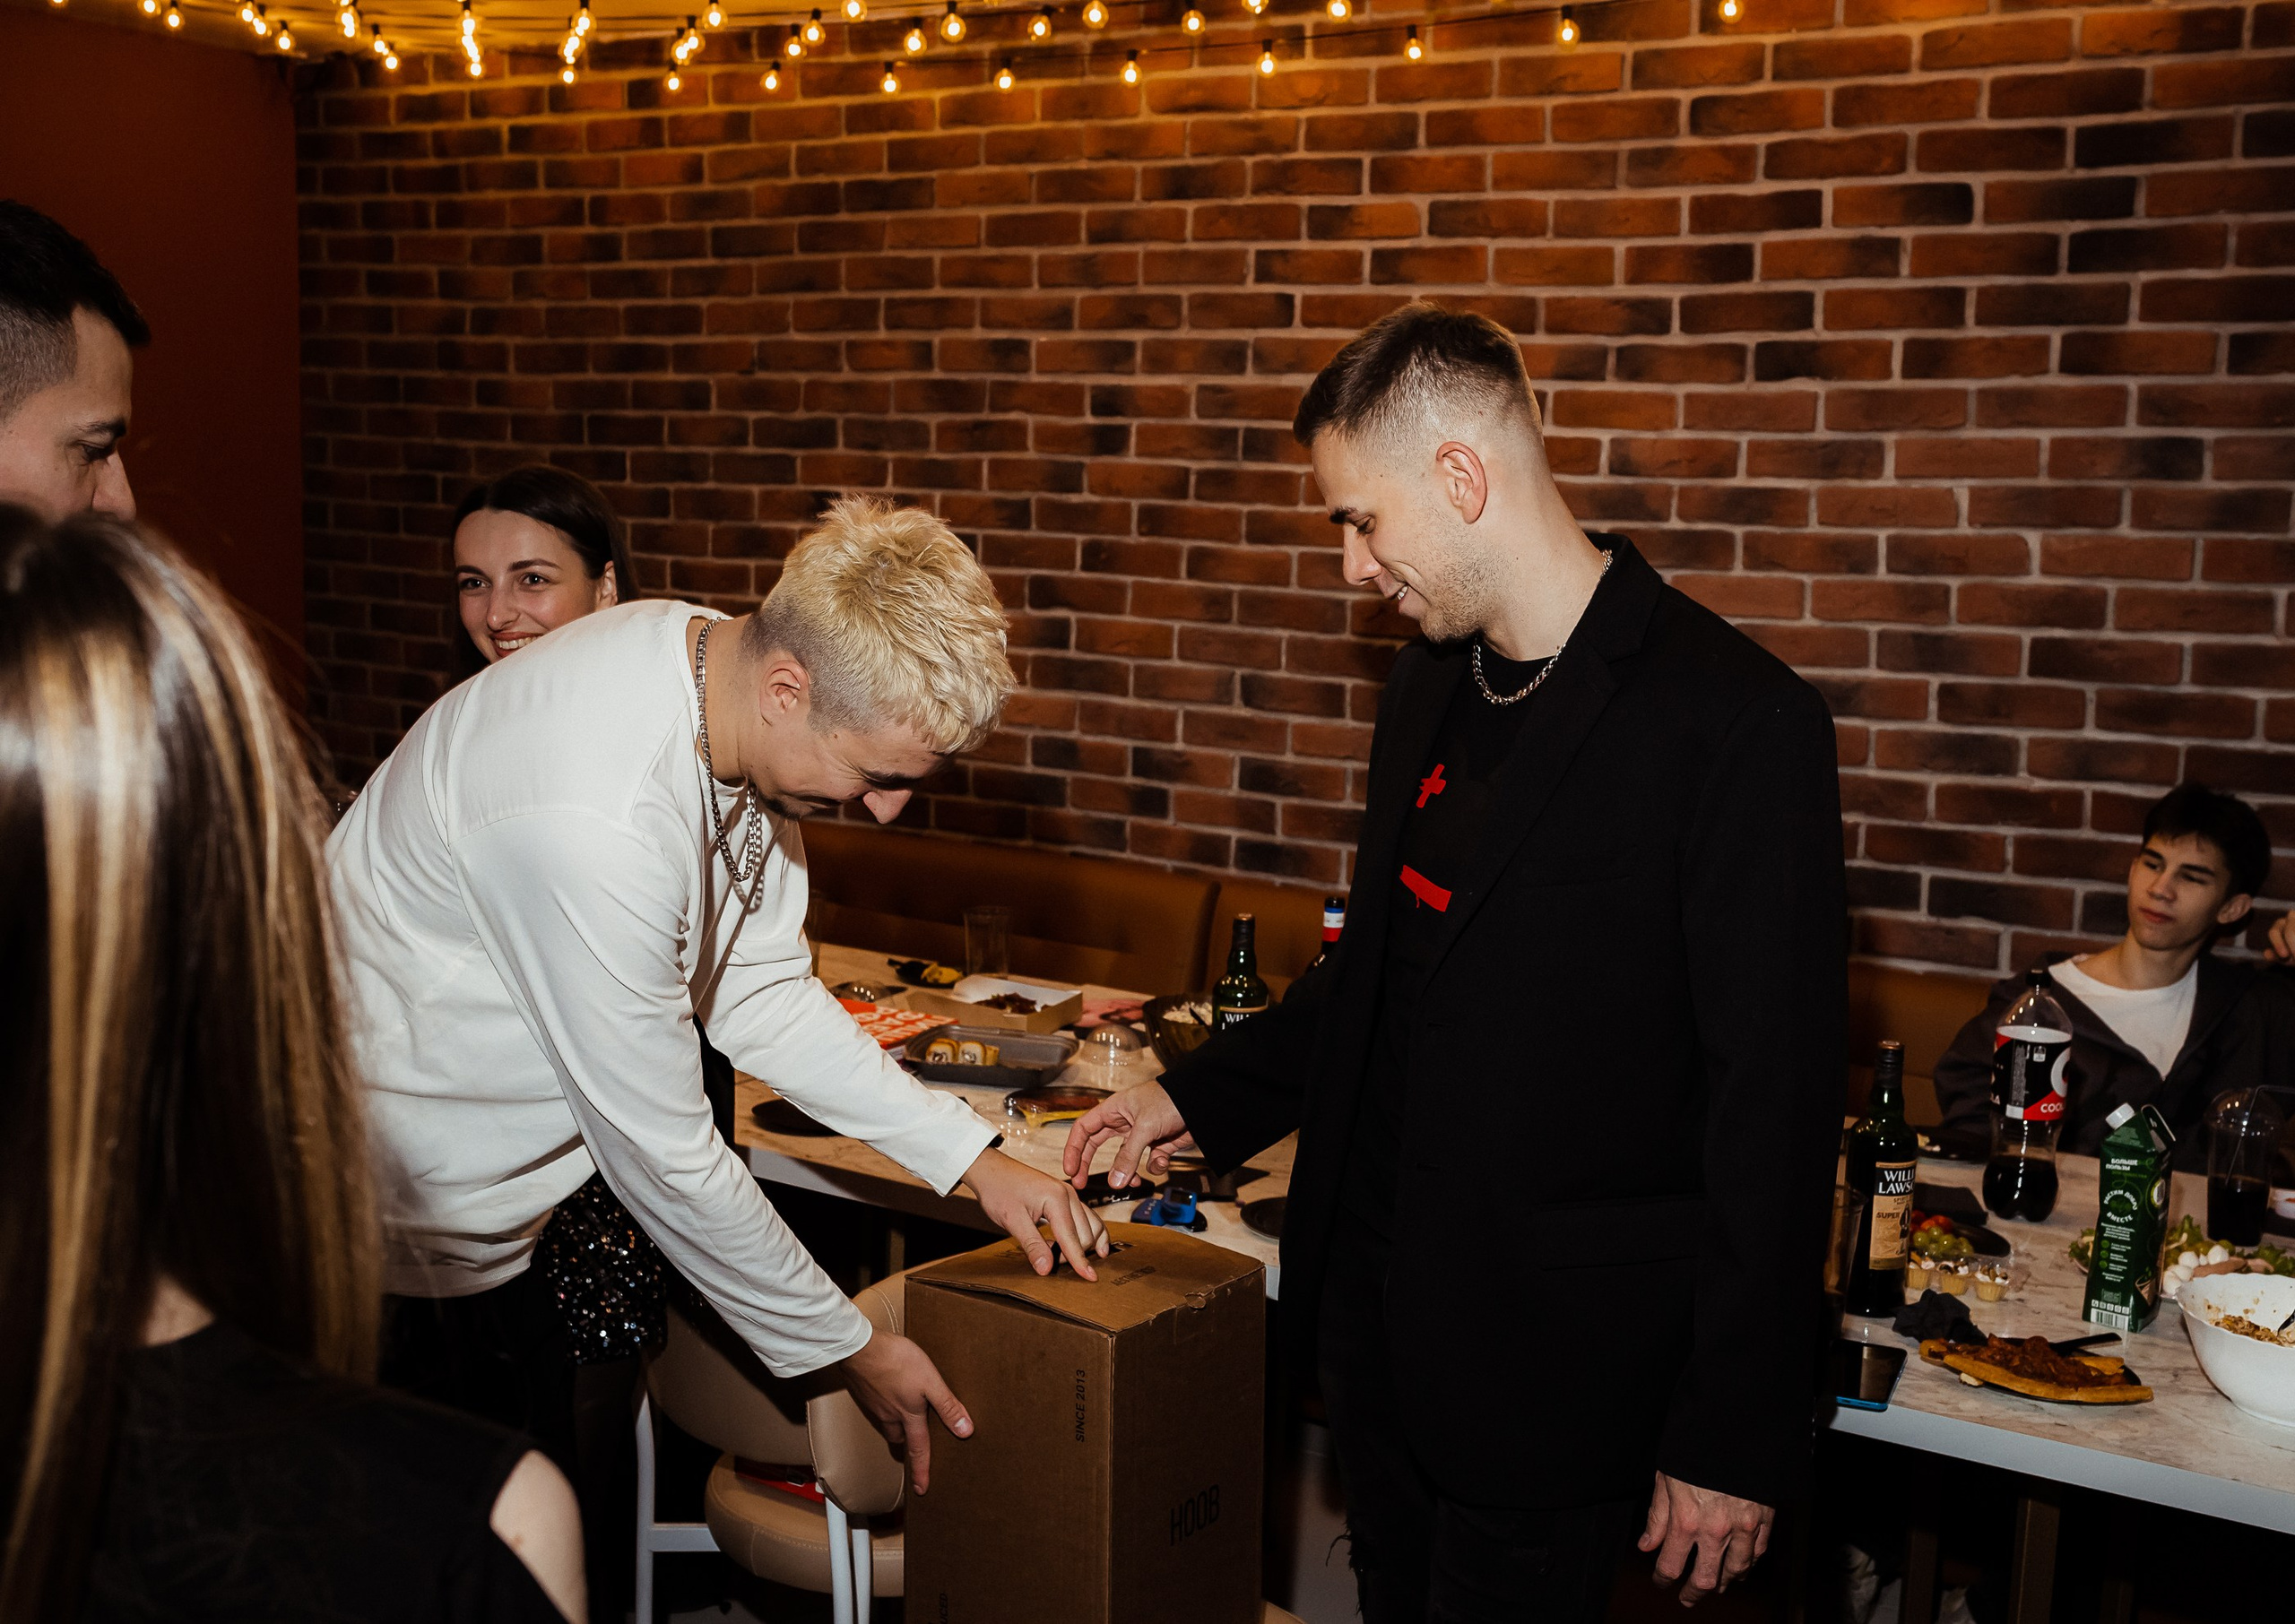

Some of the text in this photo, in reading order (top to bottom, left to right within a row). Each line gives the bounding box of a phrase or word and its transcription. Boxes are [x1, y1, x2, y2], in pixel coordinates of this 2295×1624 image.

[2105, 1163, 2131, 1171] ПОЛЬЗЫ
[2111, 1158, 2138, 1166] БОЛЬШЕ
[2103, 1189, 2124, 1205] РАСТИМ
[2107, 1211, 2134, 1223] ВМЕСТЕ
[1075, 1369, 1086, 1443] SINCE 2013
[1170, 1483, 1220, 1546] HOOB
